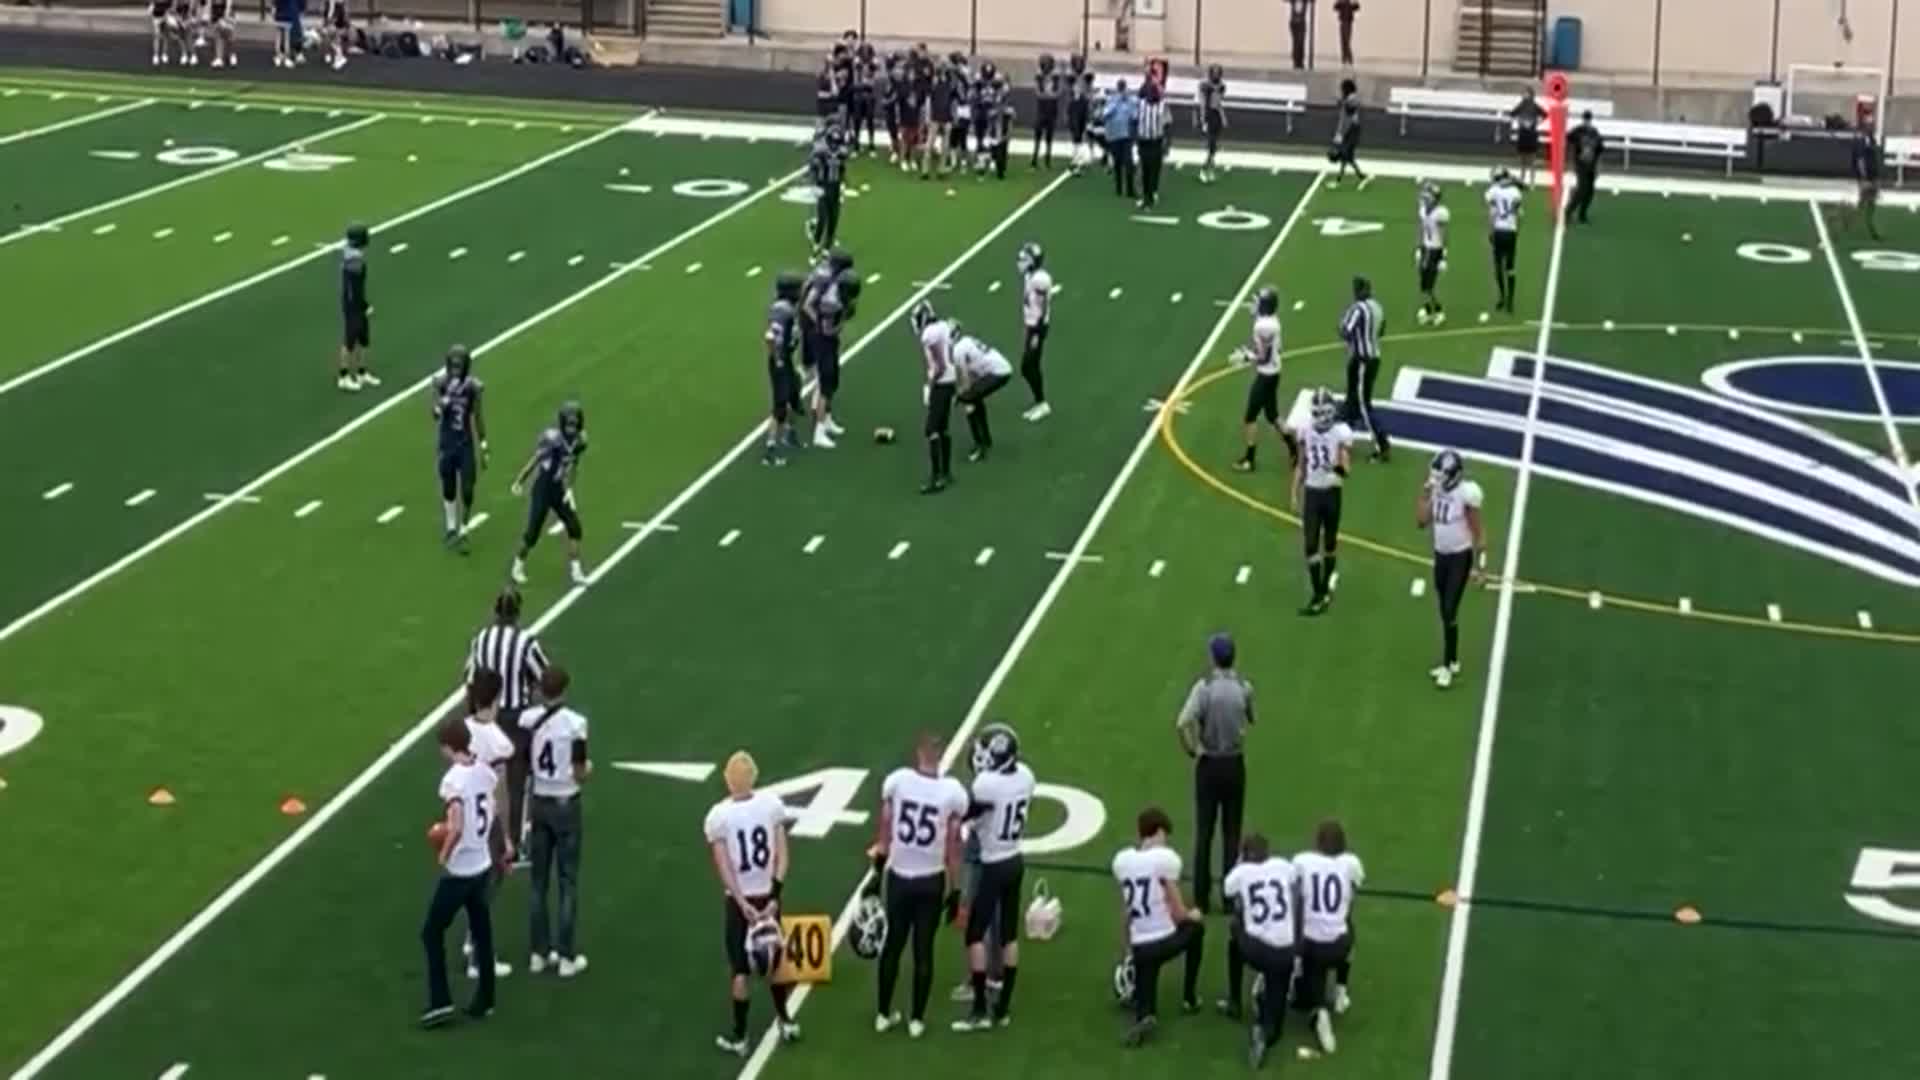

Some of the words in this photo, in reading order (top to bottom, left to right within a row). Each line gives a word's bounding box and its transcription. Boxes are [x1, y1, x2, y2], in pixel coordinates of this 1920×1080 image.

[538, 739, 556, 777] 4
[475, 792, 488, 837] 5
[899, 801, 939, 848] 55
[999, 799, 1026, 842] 15
[737, 825, 769, 873] 18
[1123, 875, 1151, 919] 27
[1249, 879, 1288, 925] 53
[1311, 872, 1342, 923] 10
[785, 924, 826, 970] 40
